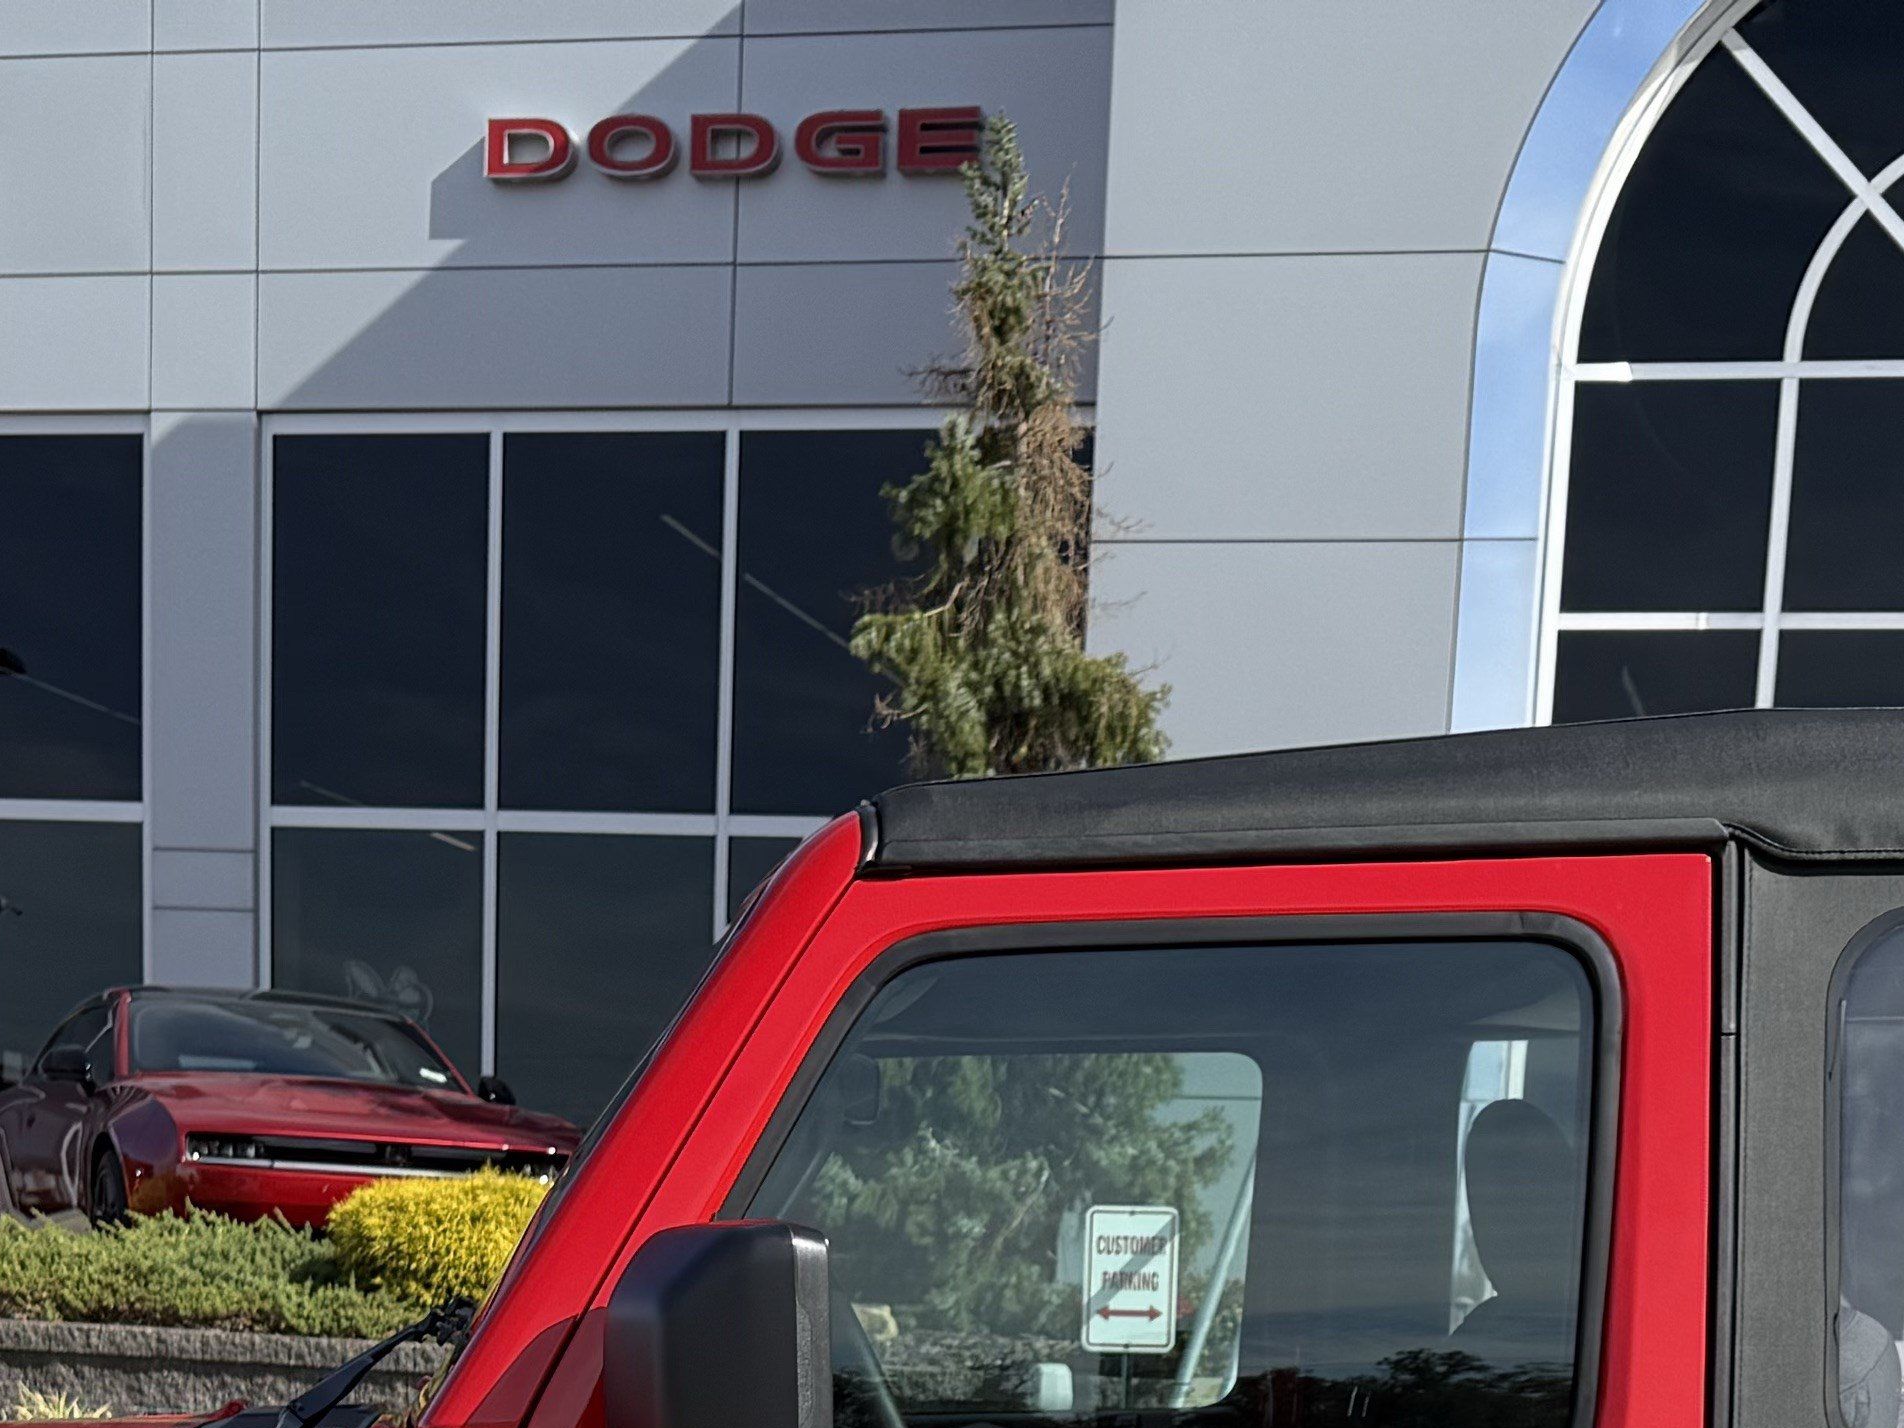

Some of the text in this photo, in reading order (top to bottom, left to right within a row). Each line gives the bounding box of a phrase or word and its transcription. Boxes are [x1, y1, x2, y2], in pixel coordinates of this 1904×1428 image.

[485, 105, 982, 180] DODGE
[1096, 1234, 1166, 1256] CUSTOMER
[1101, 1270, 1160, 1292] PARKING
